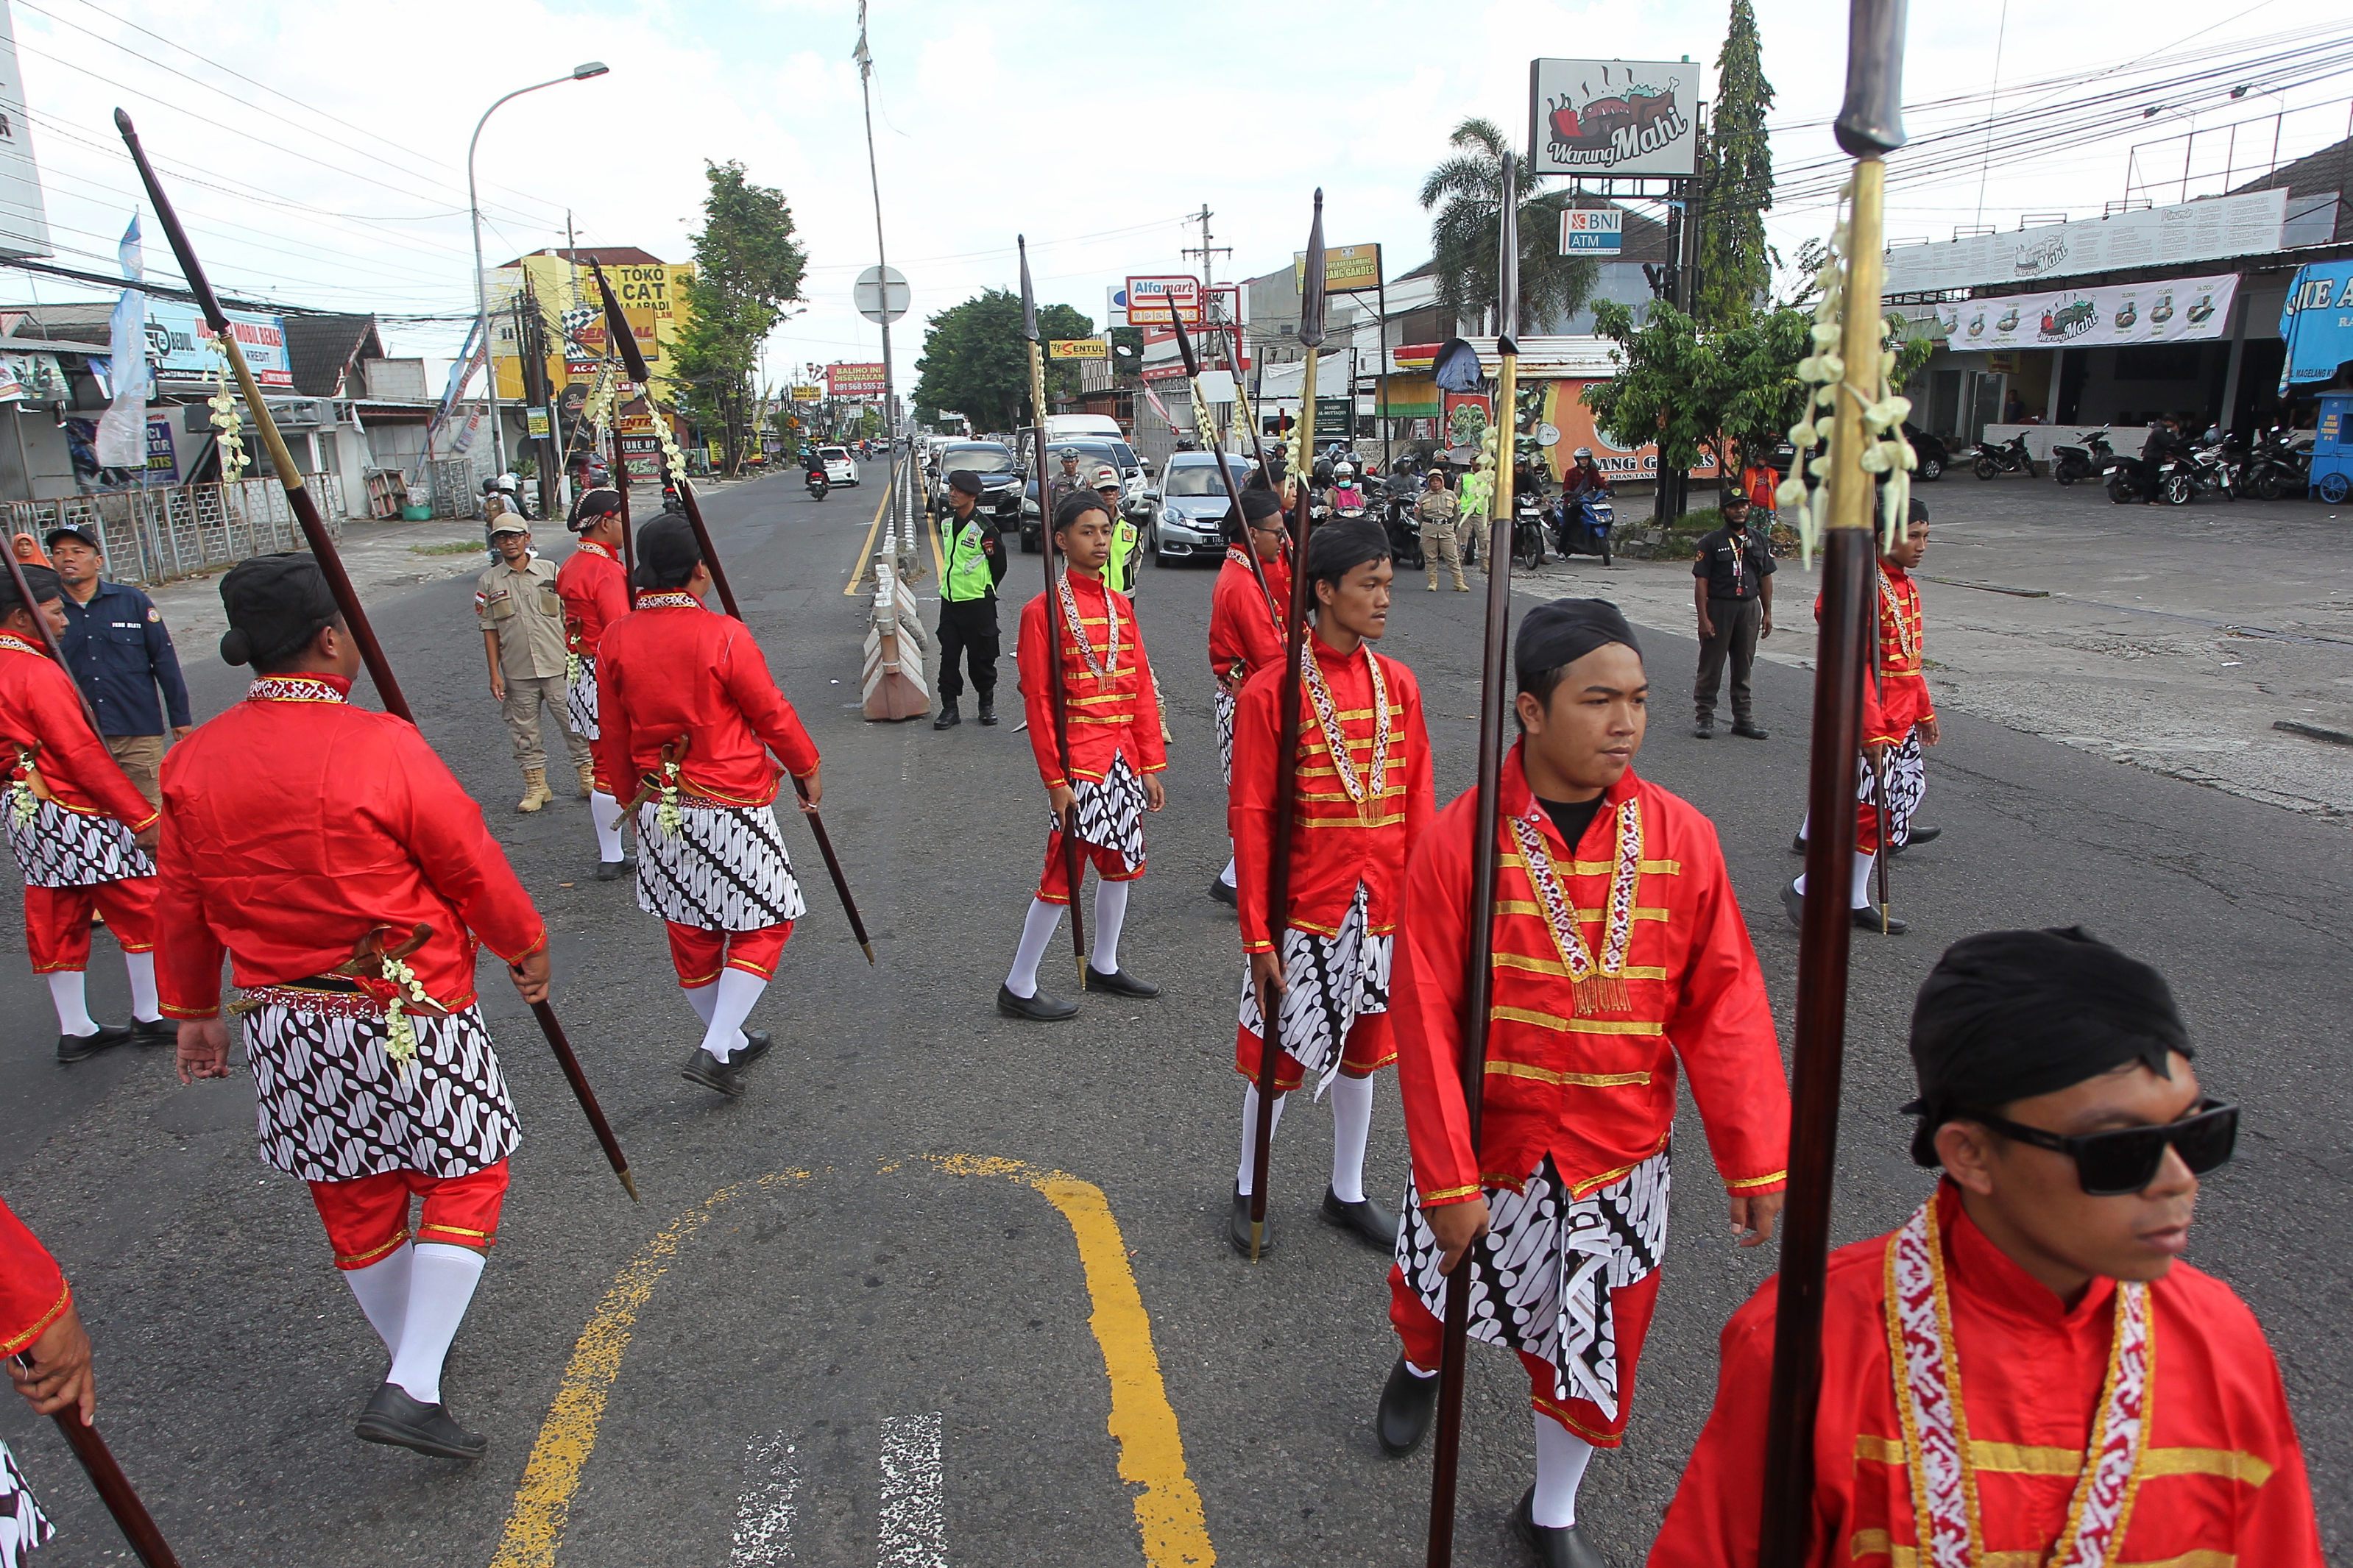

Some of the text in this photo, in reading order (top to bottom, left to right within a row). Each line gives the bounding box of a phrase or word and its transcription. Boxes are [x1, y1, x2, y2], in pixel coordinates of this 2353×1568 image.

[1548, 105, 1688, 168] Warung Mahi
[1590, 214, 1618, 230] BNI
[1571, 235, 1599, 247] ATM
[1349, 257, 1371, 266] KAMBING
[2037, 242, 2068, 273] Mahi
[620, 269, 664, 282] TOKO
[1345, 265, 1376, 278] GANDES
[622, 283, 665, 301] CAT
[1134, 282, 1194, 294] Alfamart
[2064, 310, 2099, 341] Mahi
[233, 322, 260, 344] MOBIL
[260, 328, 283, 347] BEKAS
[573, 327, 654, 339] CENAL
[1063, 343, 1104, 355] SENTUL
[246, 350, 271, 363] KREDIT
[834, 374, 885, 382] DISEWAKAN
[2296, 369, 2327, 377] MAGELANG
[622, 440, 656, 450] TUNE UP
